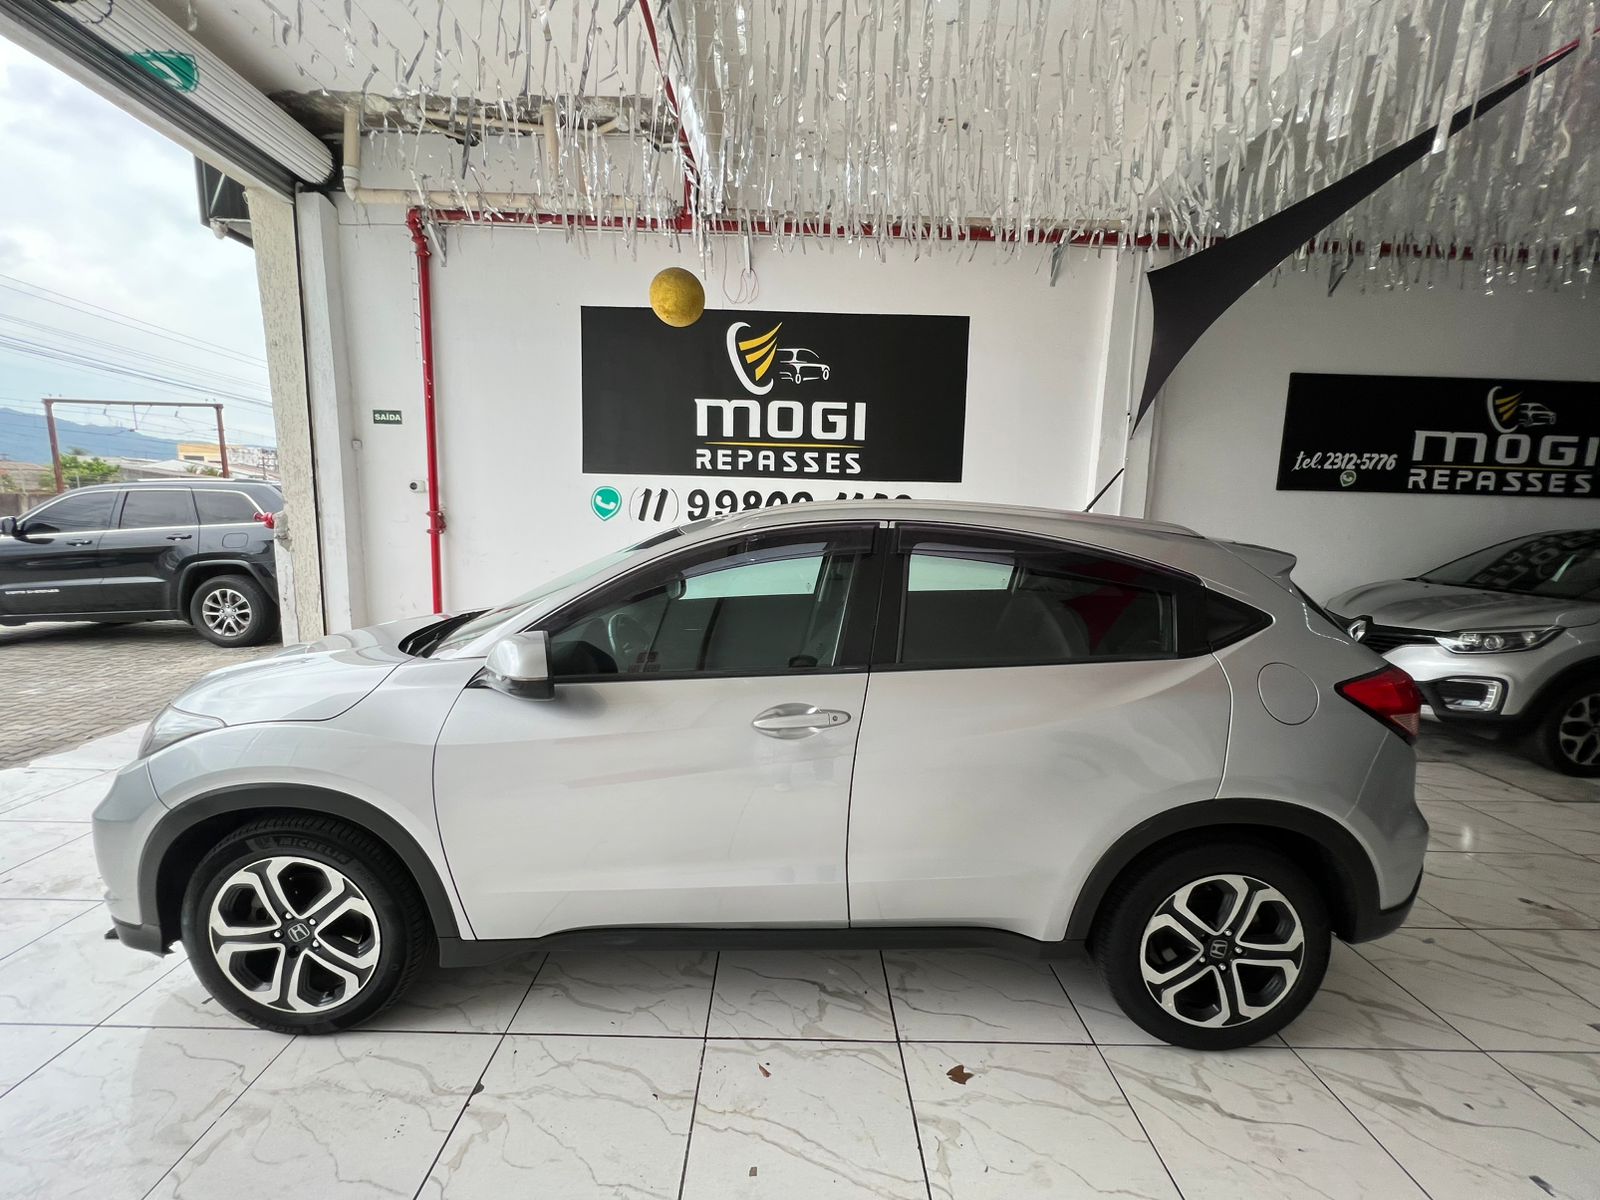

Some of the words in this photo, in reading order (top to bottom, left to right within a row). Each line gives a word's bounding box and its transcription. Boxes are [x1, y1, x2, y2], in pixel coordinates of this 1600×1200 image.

[695, 399, 867, 441] MOGI
[696, 449, 863, 475] REPASSES
[1291, 451, 1322, 472] tel.
[1411, 430, 1600, 467] MOGI
[1407, 468, 1593, 494] REPASSES
[628, 487, 680, 523] (11)
